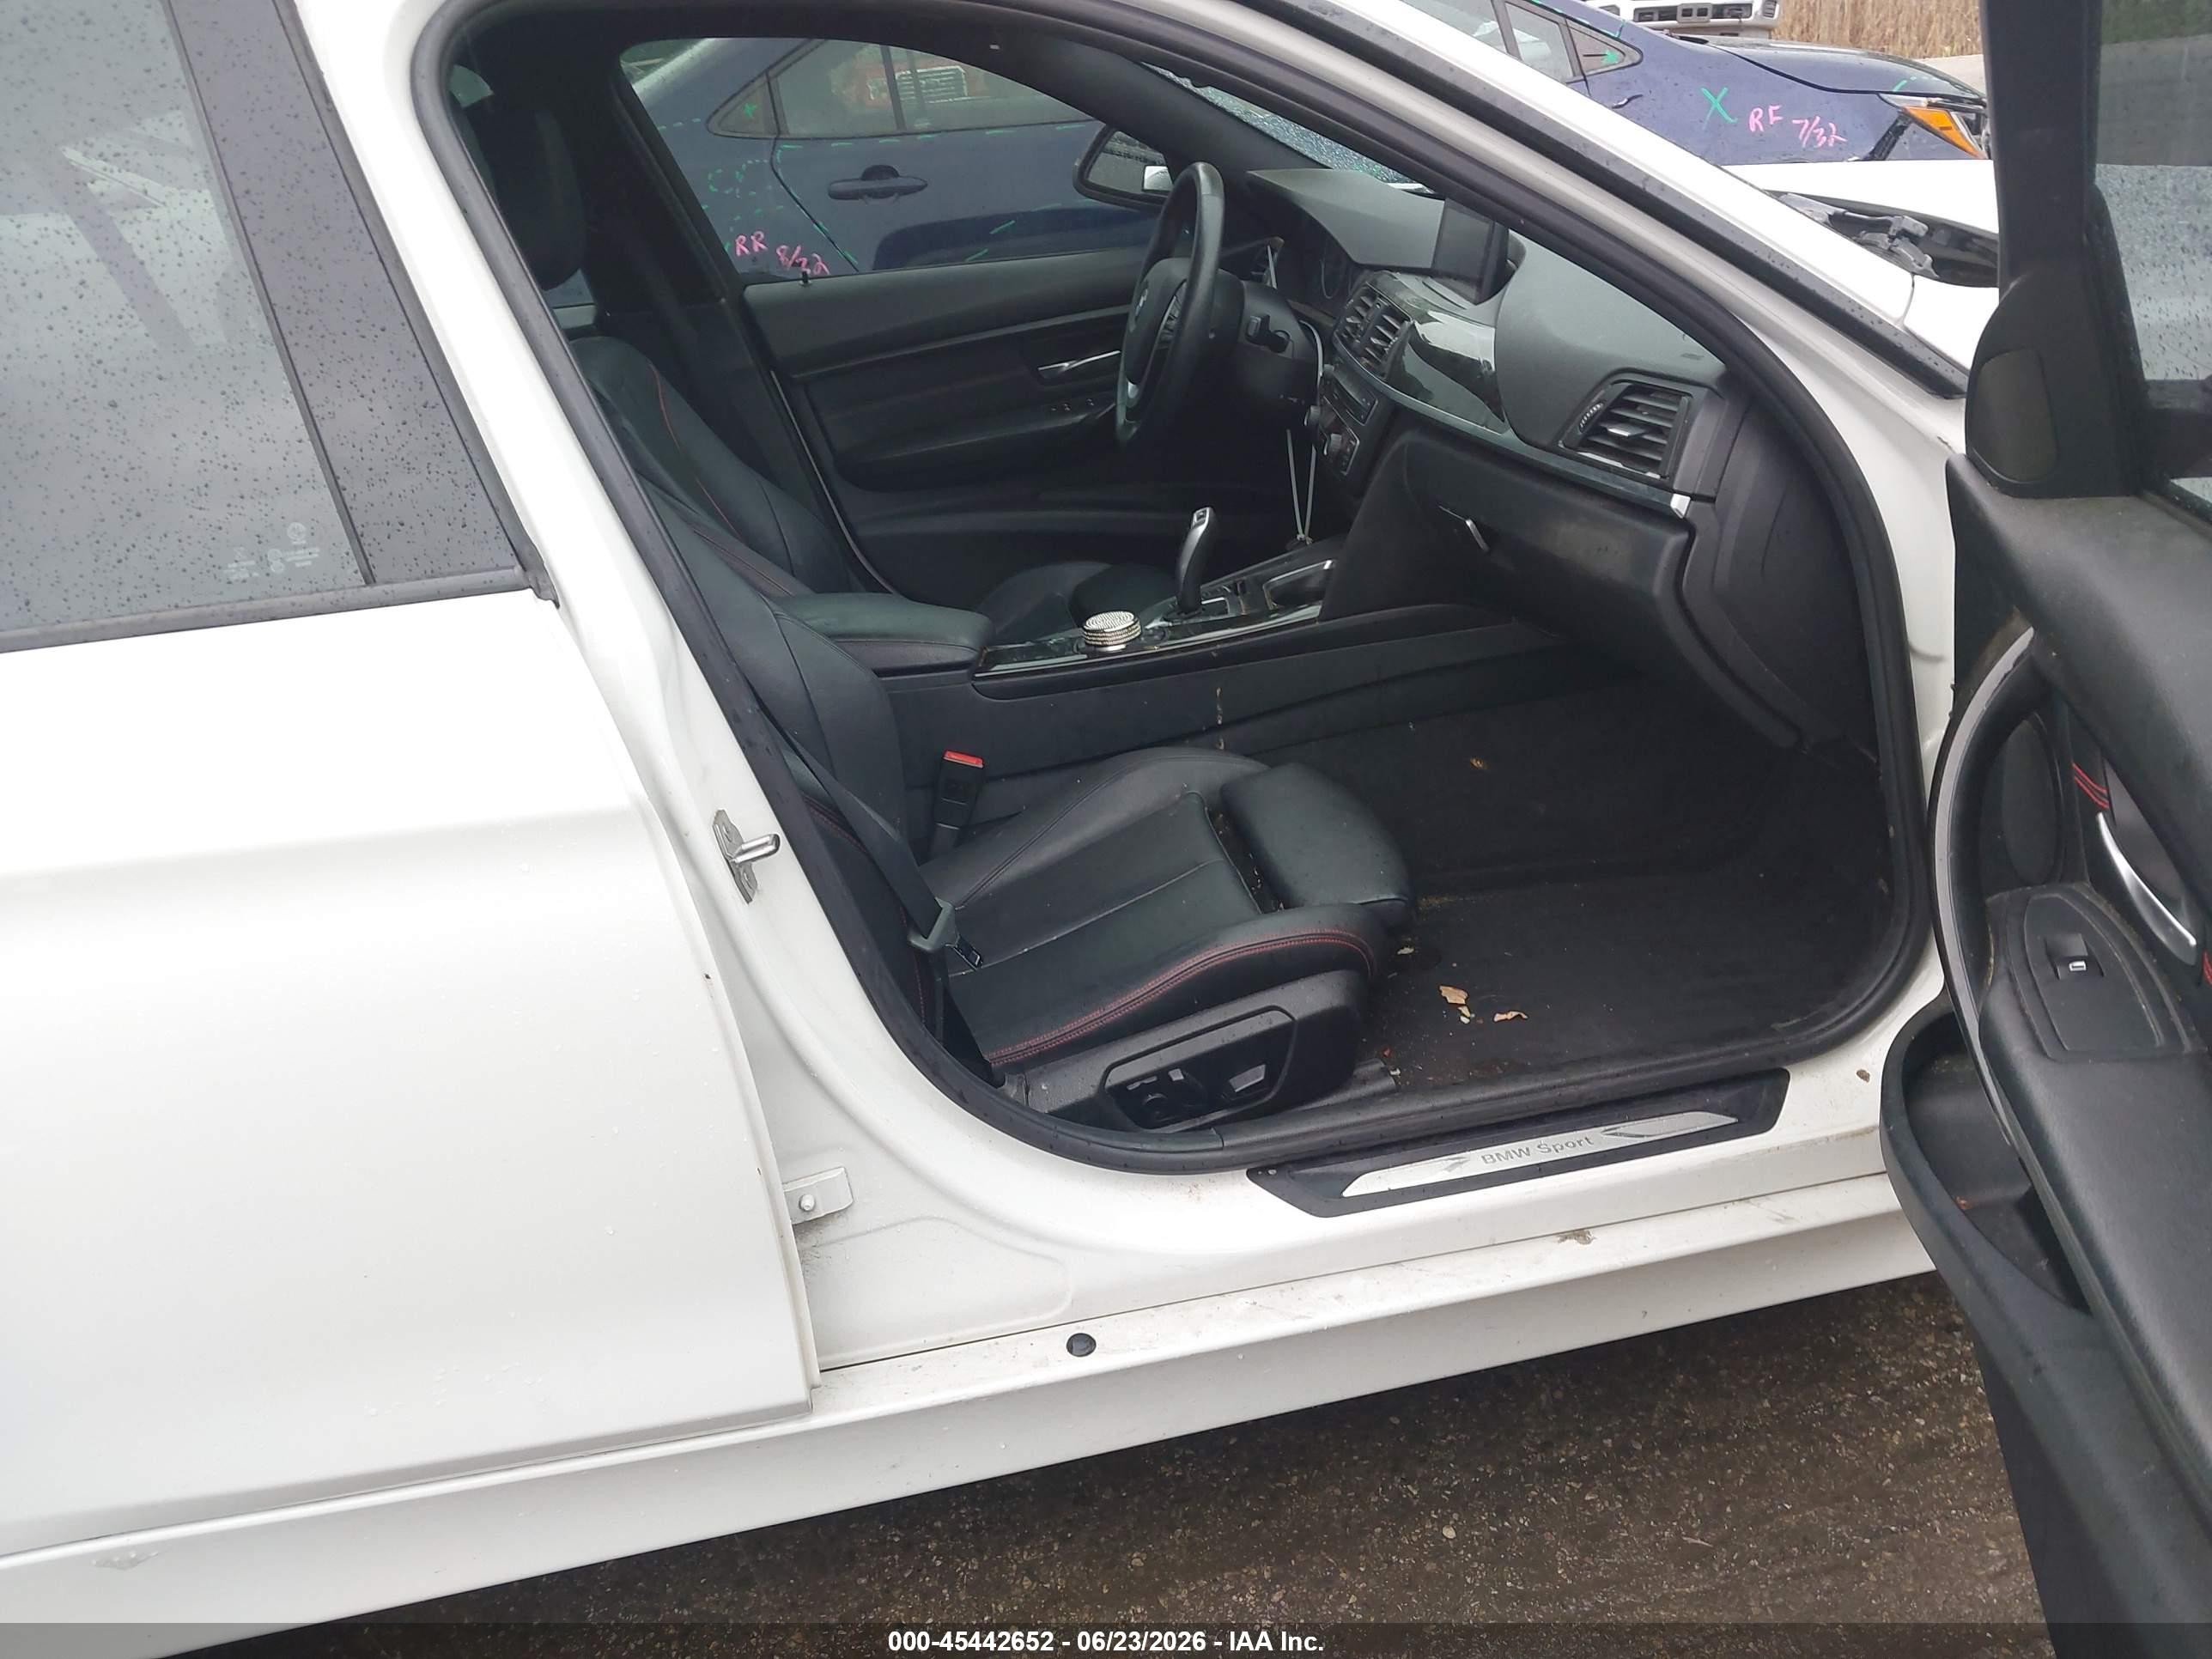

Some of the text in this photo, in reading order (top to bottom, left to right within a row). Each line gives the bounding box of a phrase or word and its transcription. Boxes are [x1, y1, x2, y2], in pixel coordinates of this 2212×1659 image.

[1748, 105, 1848, 149] RF 7/32
[735, 230, 768, 257] RR
[1481, 1136, 1595, 1164] BMW Sport
